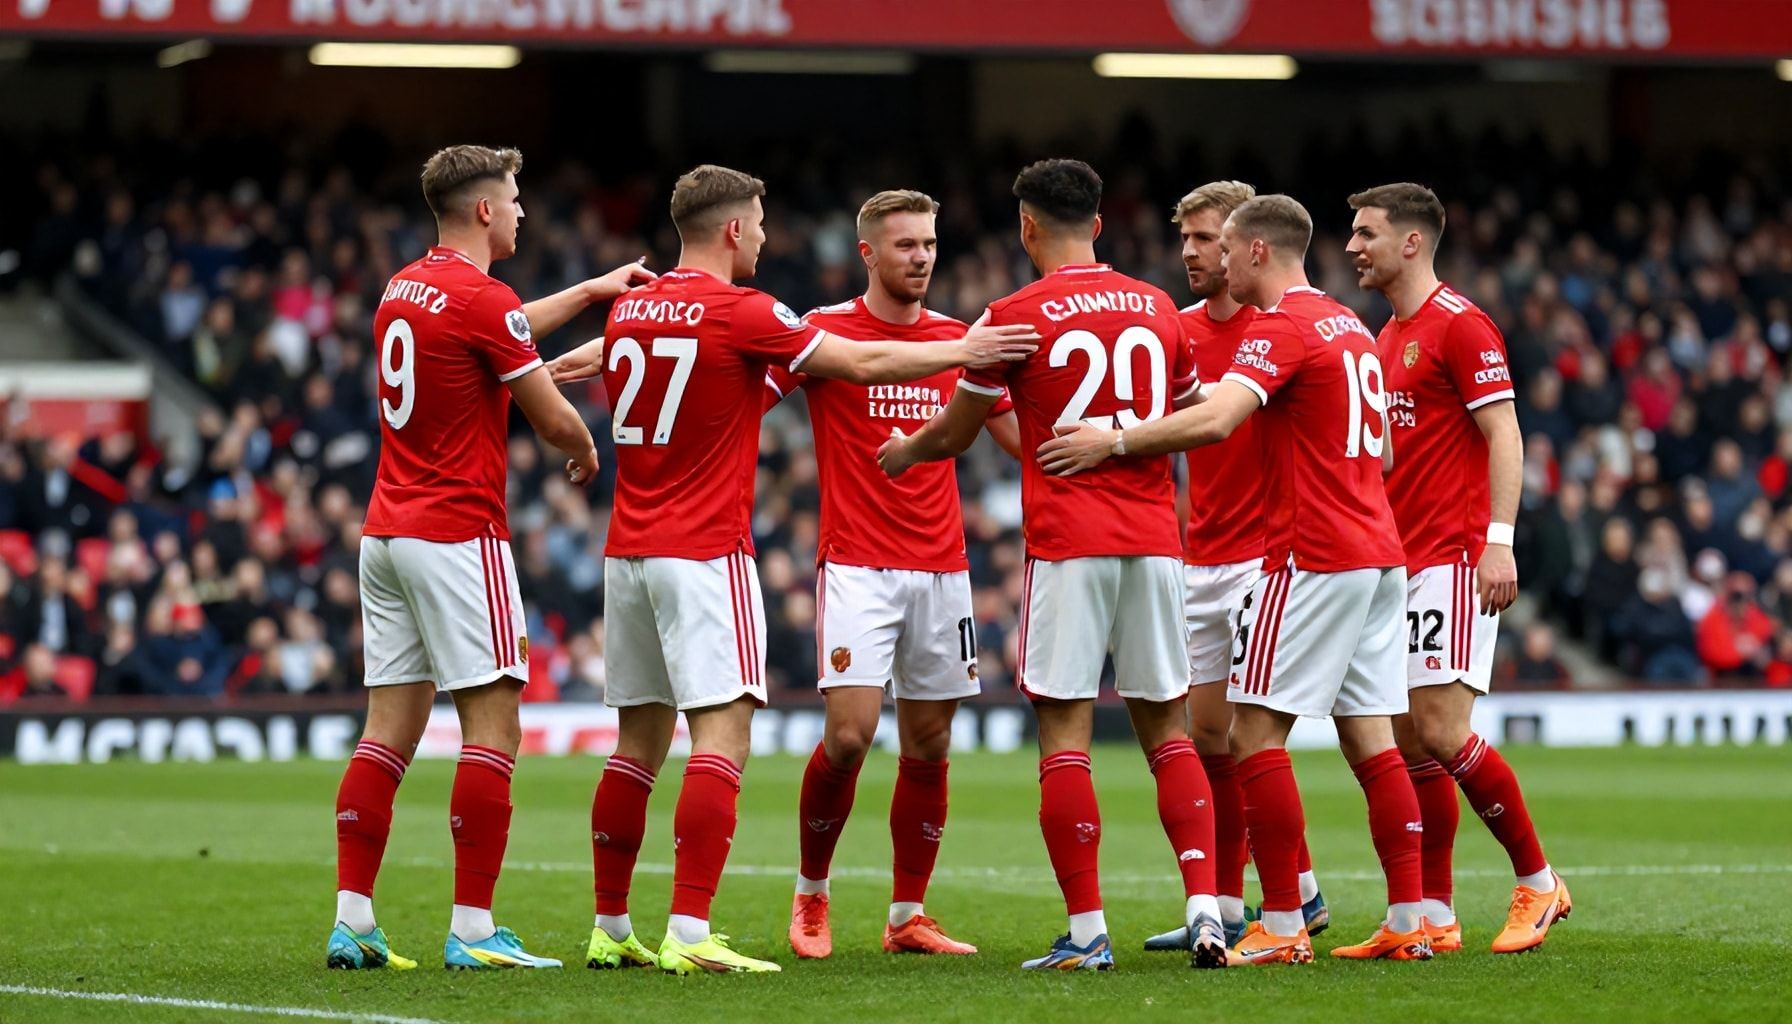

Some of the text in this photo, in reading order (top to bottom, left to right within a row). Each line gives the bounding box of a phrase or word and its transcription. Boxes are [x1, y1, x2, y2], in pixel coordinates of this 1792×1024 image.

[382, 318, 415, 429] 9
[609, 337, 698, 445] 27
[1343, 350, 1387, 457] 19
